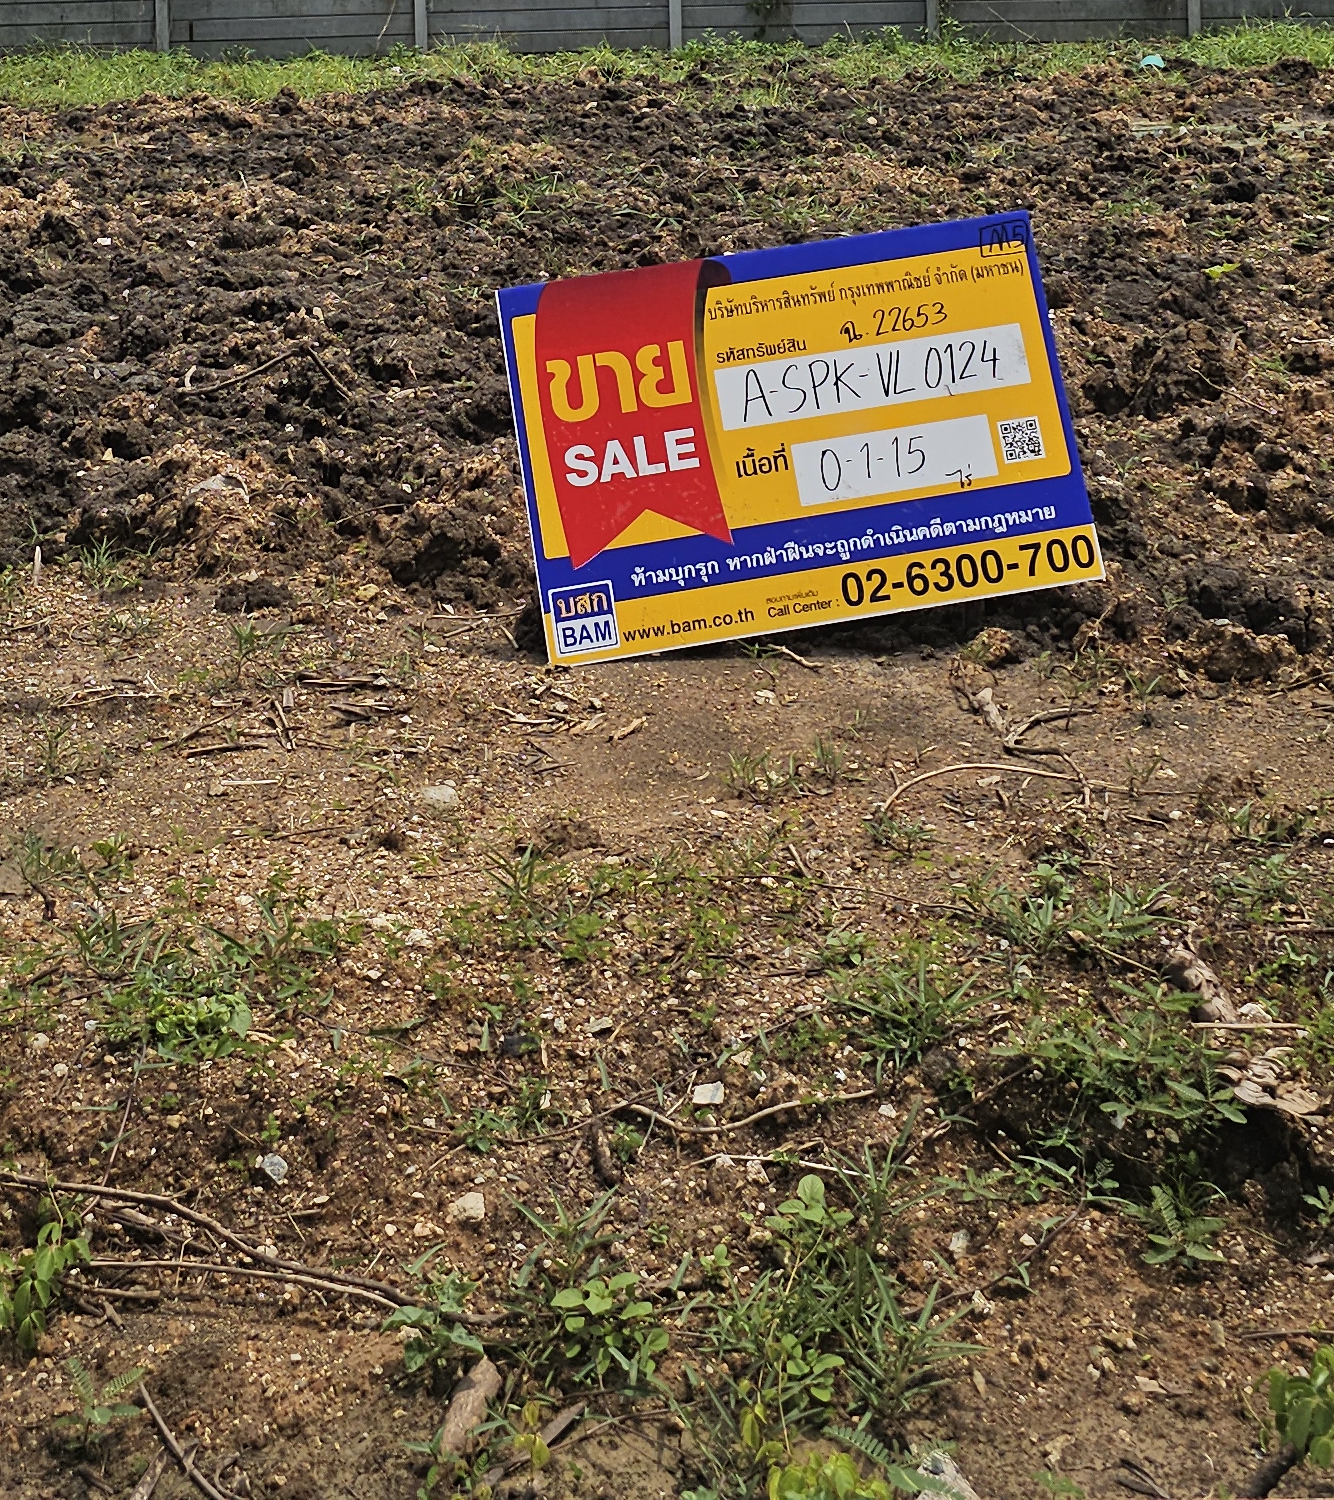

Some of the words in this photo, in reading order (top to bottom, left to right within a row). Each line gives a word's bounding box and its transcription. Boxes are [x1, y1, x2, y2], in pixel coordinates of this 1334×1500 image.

[708, 281, 836, 321] บริษัทบริหารสินทรัพย์
[838, 266, 932, 307] กรุงเทพพาณิชย์
[934, 263, 969, 286] จำกัด
[716, 338, 808, 365] รหัสทรัพย์สิน
[545, 339, 693, 423] ขาย
[564, 427, 700, 487] SALE
[735, 443, 789, 479] เนื้อที่
[630, 557, 720, 587] ห้ามบุกรุก
[767, 603, 791, 619] Call
[792, 599, 833, 615] Center
[840, 533, 1097, 609] 02-6300-700
[556, 592, 609, 618] บสก
[561, 619, 613, 648] BAM
[622, 607, 756, 643] www.bam.co.th
